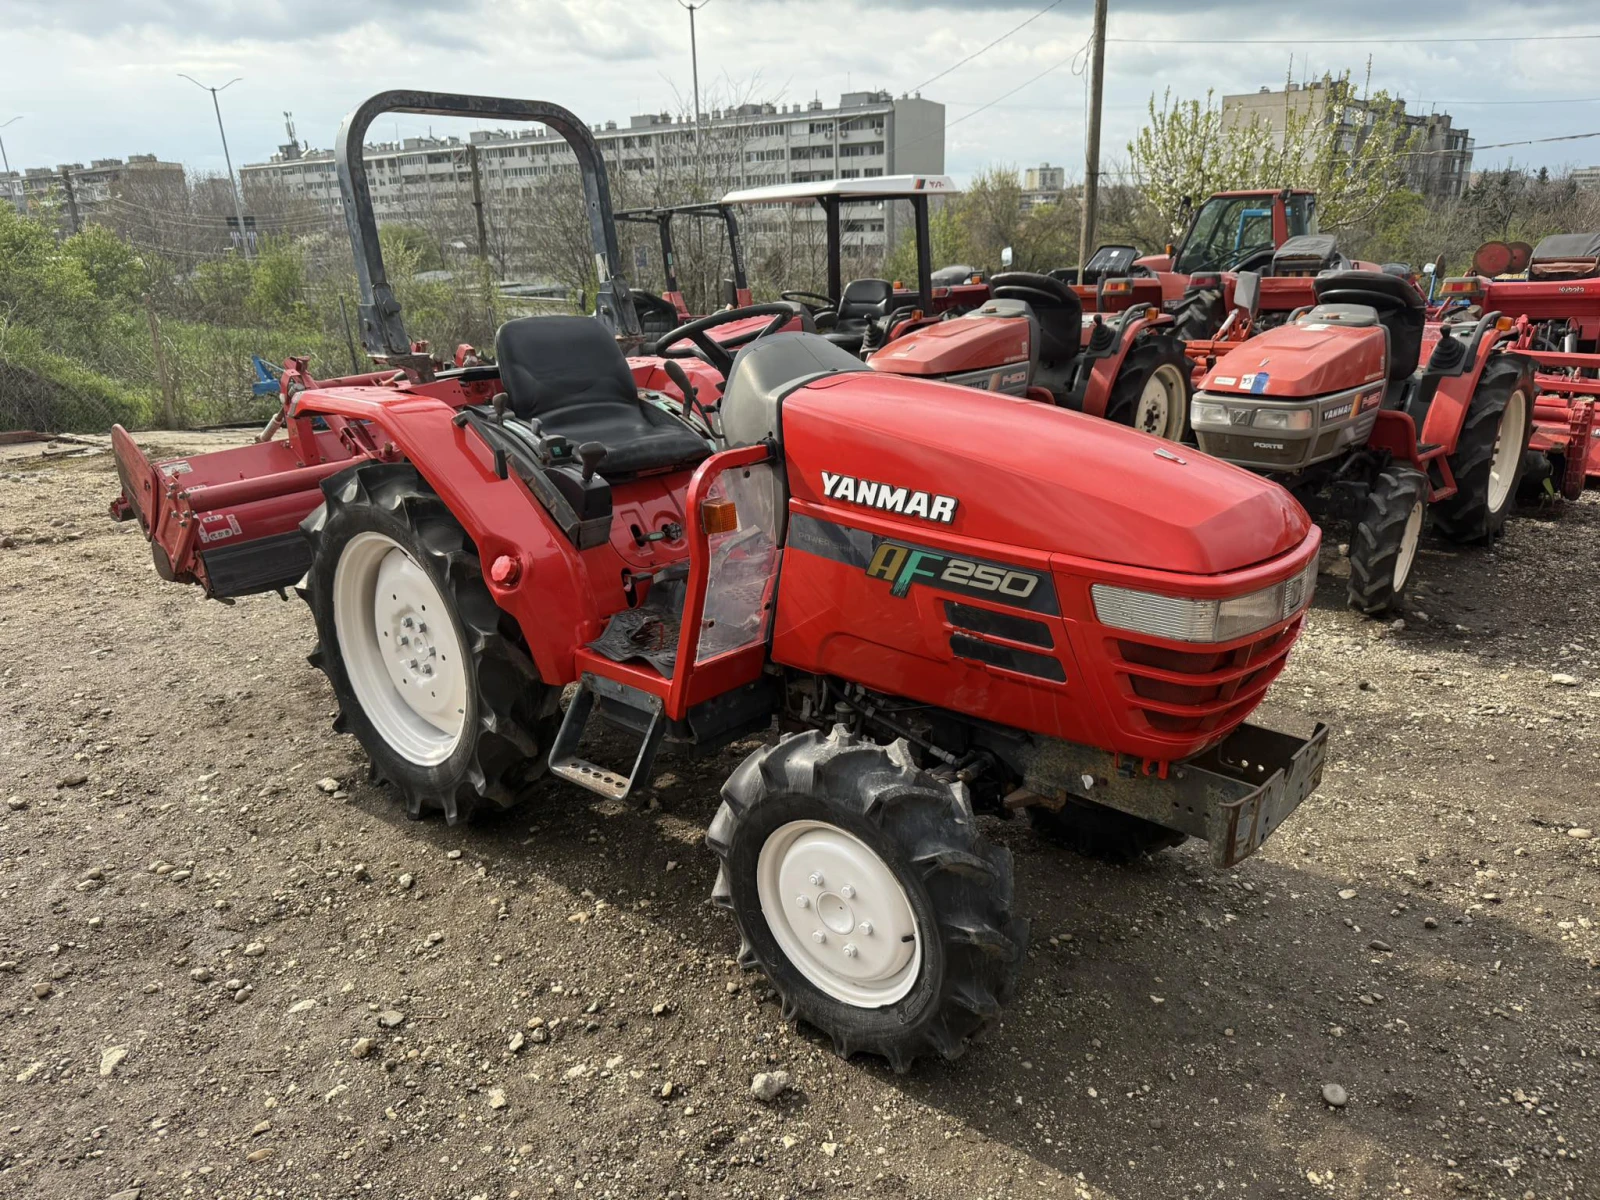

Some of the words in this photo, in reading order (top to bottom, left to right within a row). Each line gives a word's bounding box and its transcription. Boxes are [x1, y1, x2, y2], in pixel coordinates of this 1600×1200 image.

[1558, 285, 1585, 294] Kubota
[1253, 441, 1284, 450] FORTE
[820, 470, 958, 524] YANMAR
[797, 531, 831, 547] POWER
